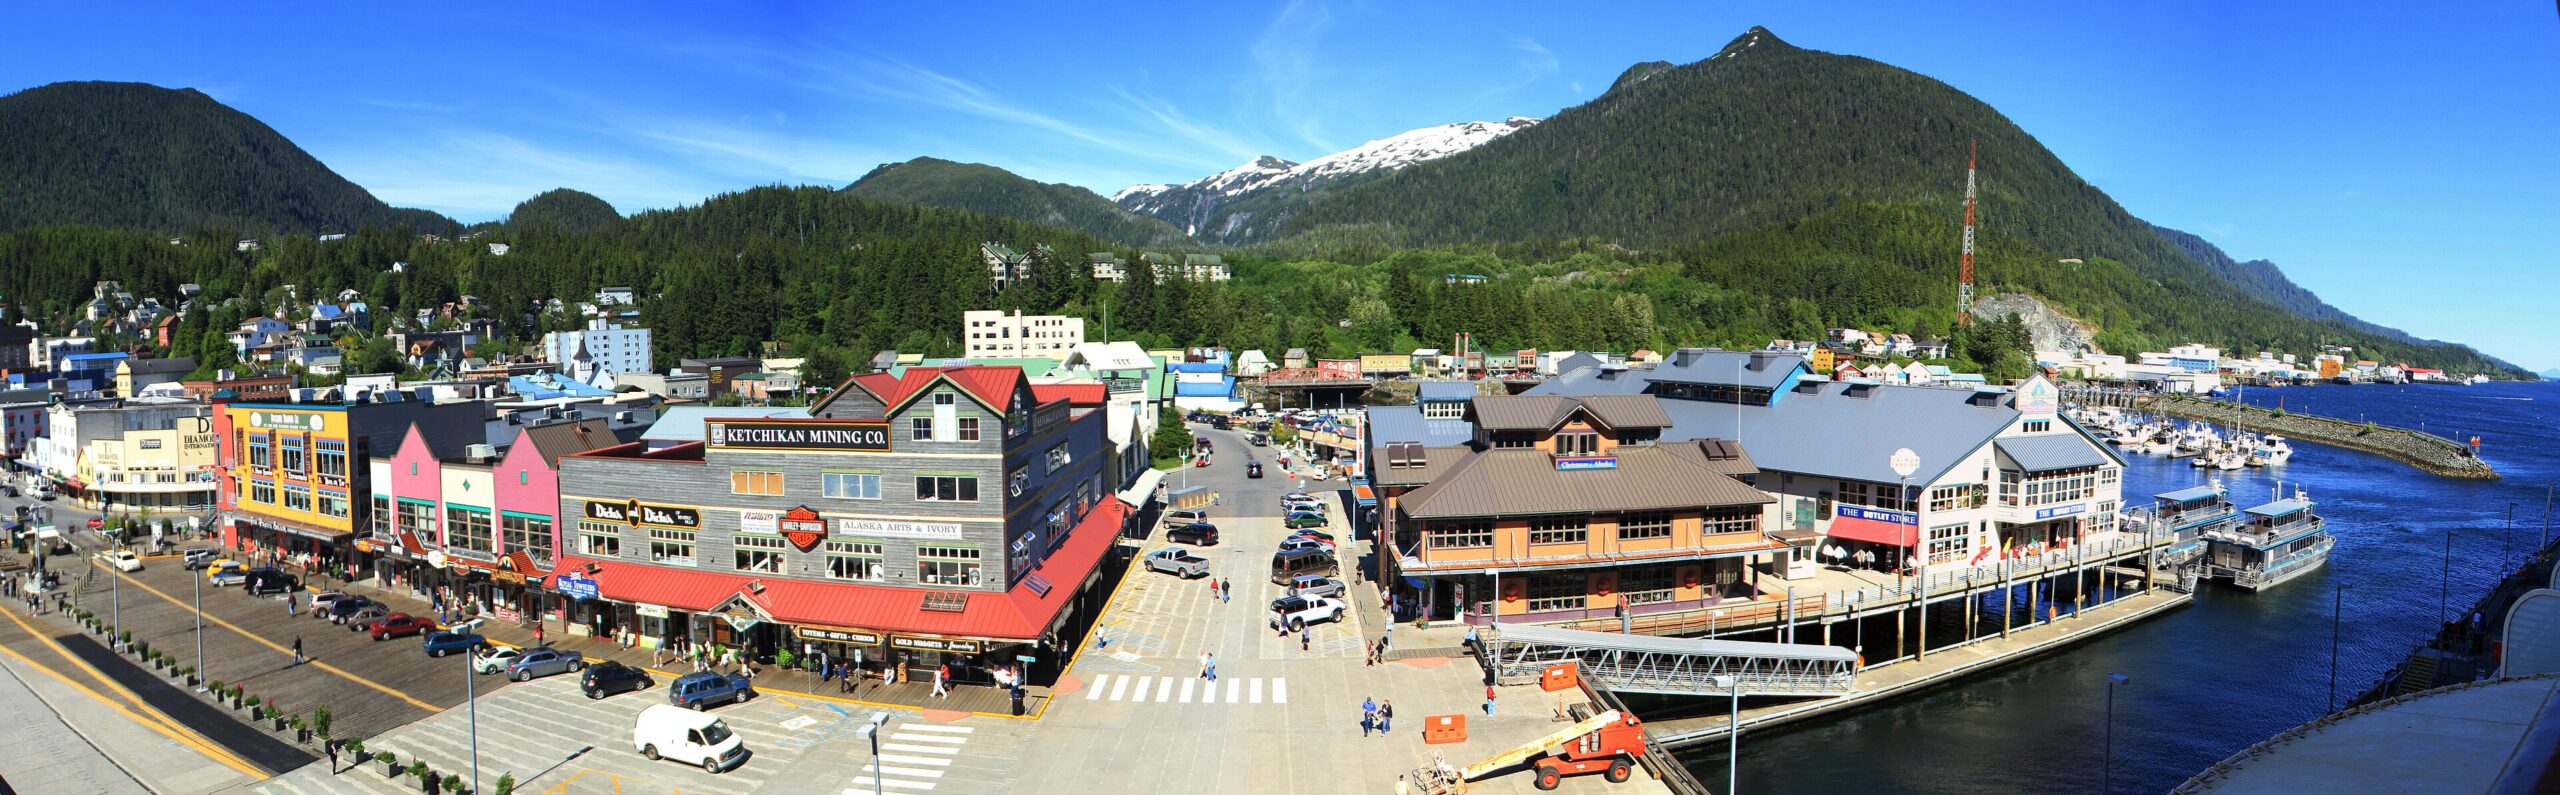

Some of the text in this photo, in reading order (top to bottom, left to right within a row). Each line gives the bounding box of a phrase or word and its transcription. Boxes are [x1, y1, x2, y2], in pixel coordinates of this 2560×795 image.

[727, 428, 886, 445] KETCHIKAN MINING CO.
[628, 506, 639, 517] and
[1841, 507, 1917, 525] THE OUTLET STORE
[2039, 509, 2050, 518] THE
[782, 521, 823, 532] HARLEY-DAVIDSON
[844, 521, 883, 531] ALASKA
[887, 523, 912, 532] ARTS
[927, 524, 958, 534] IVORY
[791, 533, 814, 543] CYCLES
[801, 628, 875, 643] TOTEMS GIFTS CURIOS
[895, 637, 976, 653] GOLD NUGGETS Jewelry
